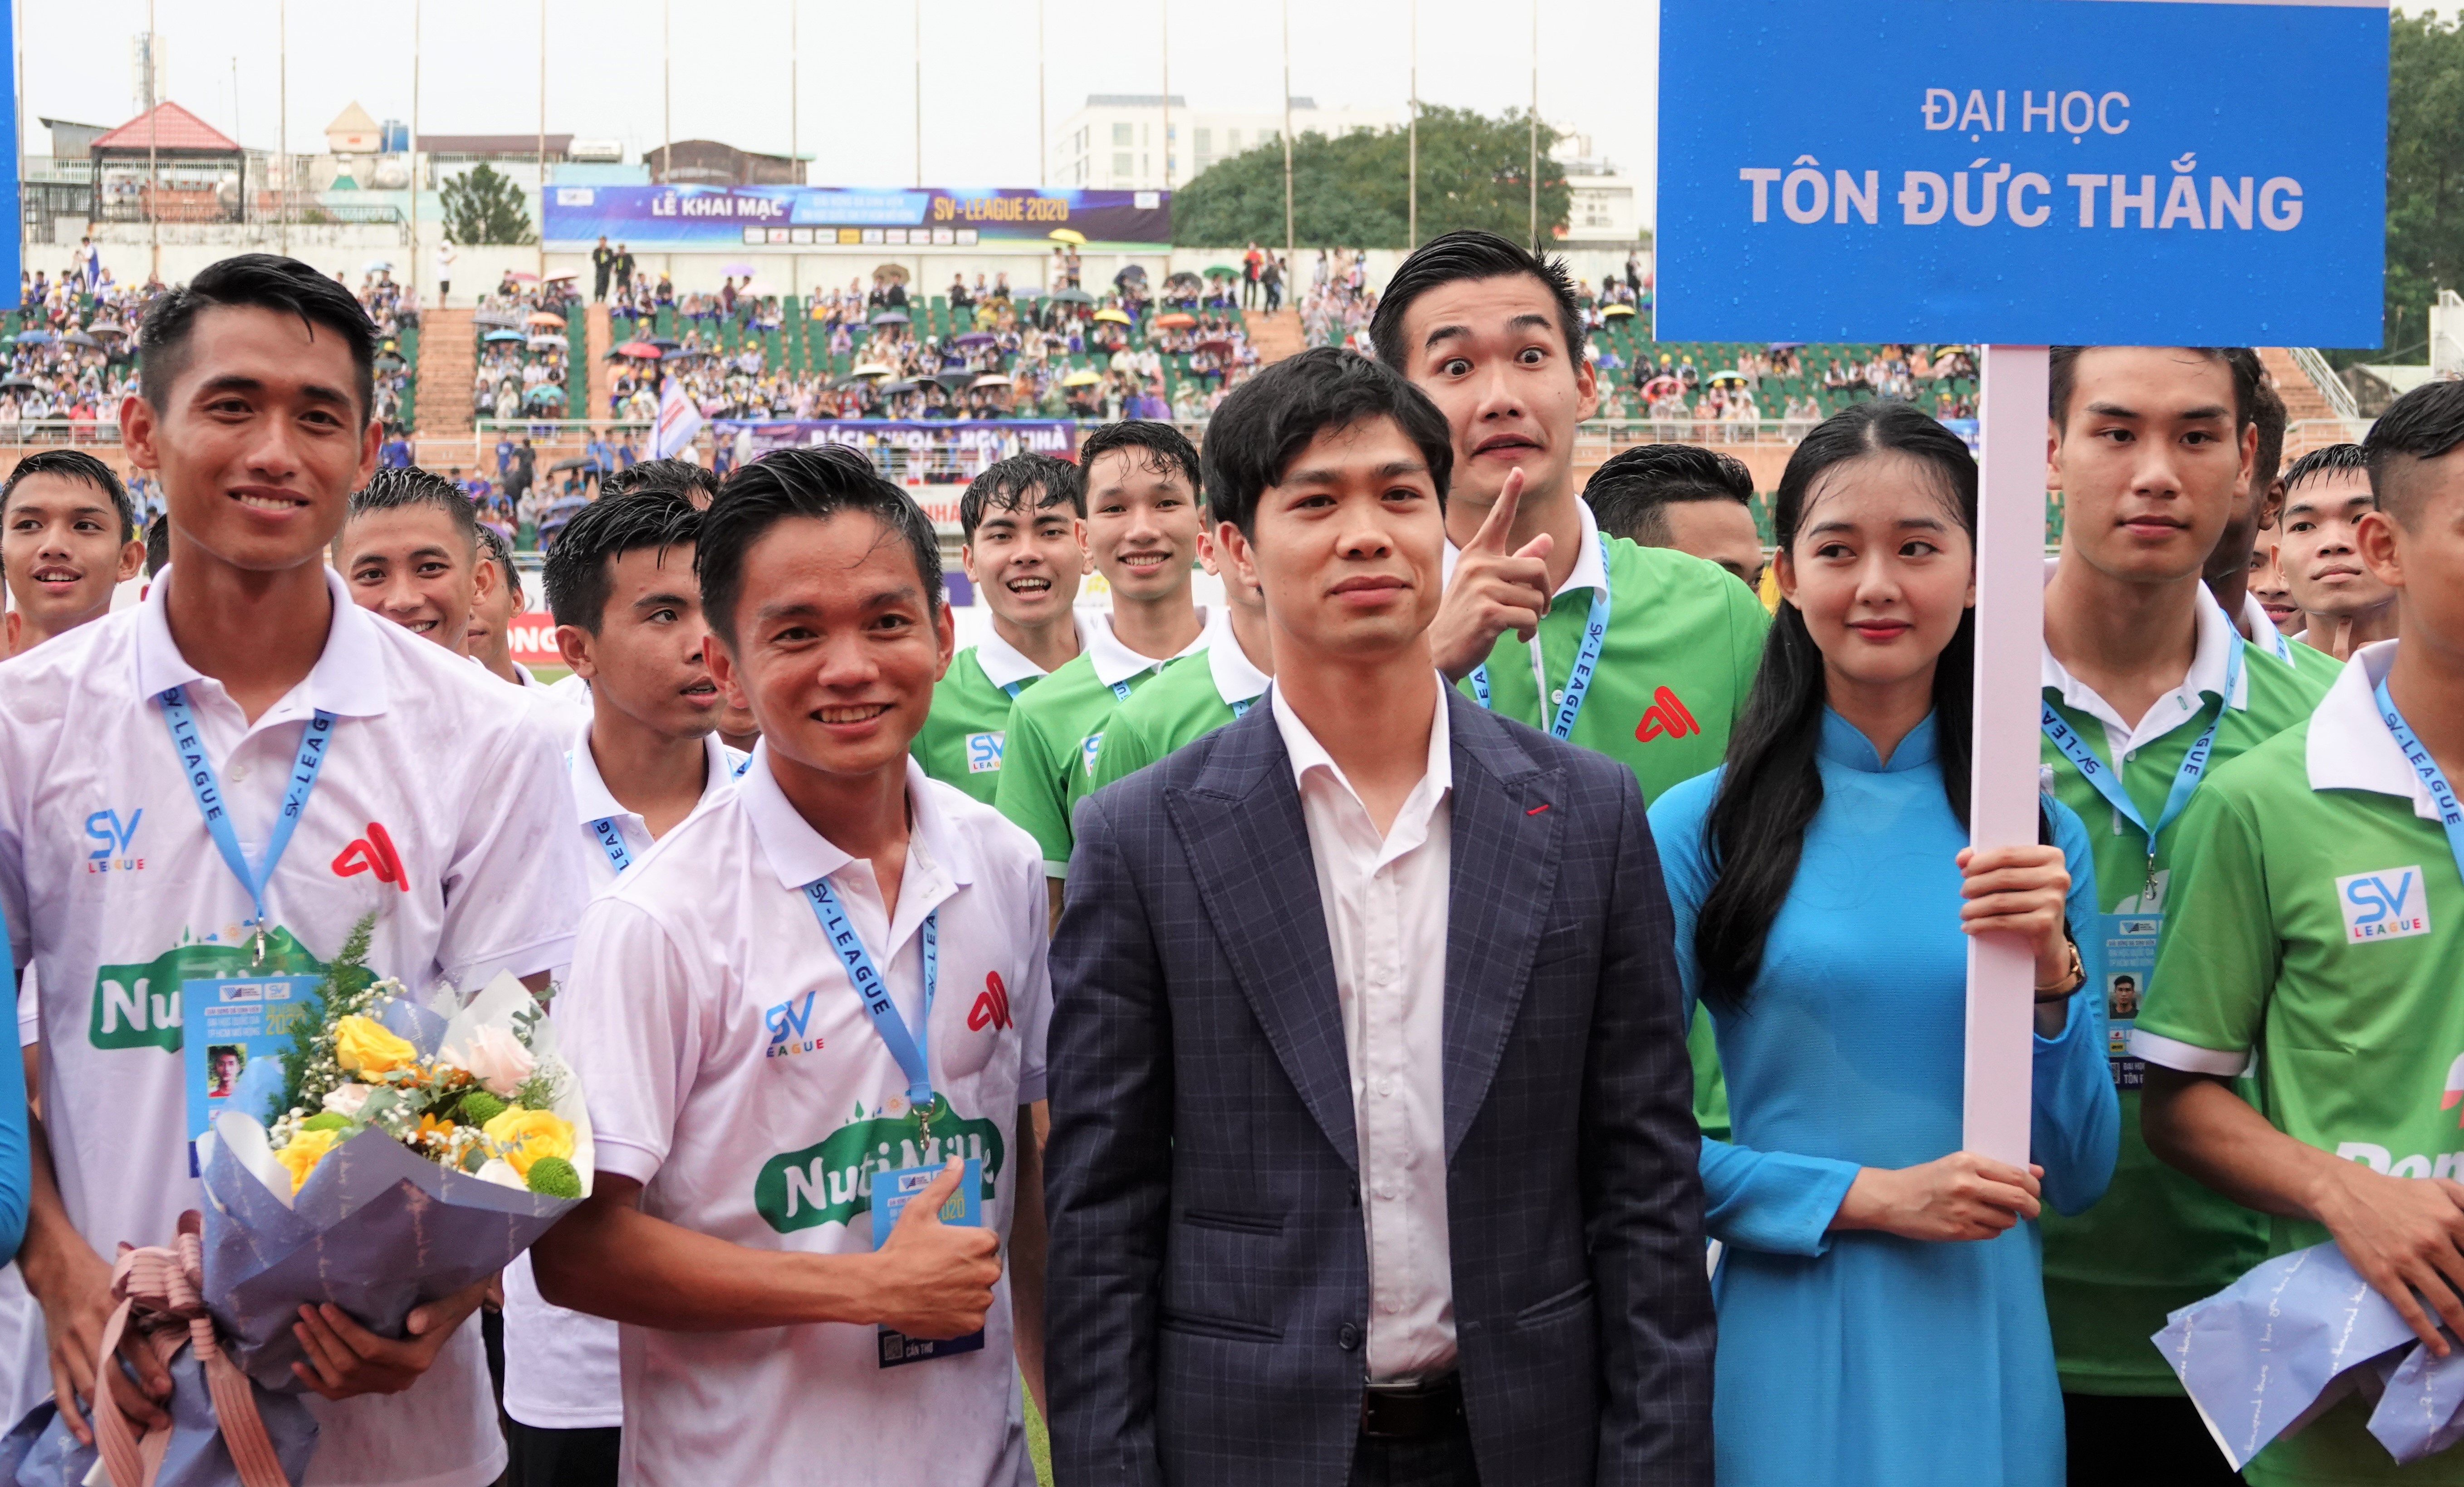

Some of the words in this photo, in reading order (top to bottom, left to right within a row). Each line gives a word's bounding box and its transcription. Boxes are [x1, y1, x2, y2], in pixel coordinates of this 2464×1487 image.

[1921, 88, 2005, 142] ĐẠI
[2023, 90, 2130, 144] HỌC
[652, 190, 677, 216] LỄ
[681, 198, 733, 216] KHAI
[737, 197, 784, 221] MẠC
[1740, 155, 1878, 224] TÔN
[1898, 158, 2051, 227] ĐỨC
[2067, 152, 2303, 231] THẮNG
[1026, 199, 1069, 221] 2020
[971, 734, 1005, 762] SV
[973, 762, 1000, 770] LEAG
[2386, 713, 2462, 825] SV-LEAGUE
[85, 808, 143, 859] SV
[88, 859, 145, 873] LEGUE
[2346, 871, 2413, 924] SV
[2355, 918, 2421, 938] LEAGUE
[810, 883, 890, 1015] SV-LEAGUE
[765, 991, 816, 1044] SV
[766, 1037, 824, 1057] EAGUE
[941, 1198, 965, 1221] 020
